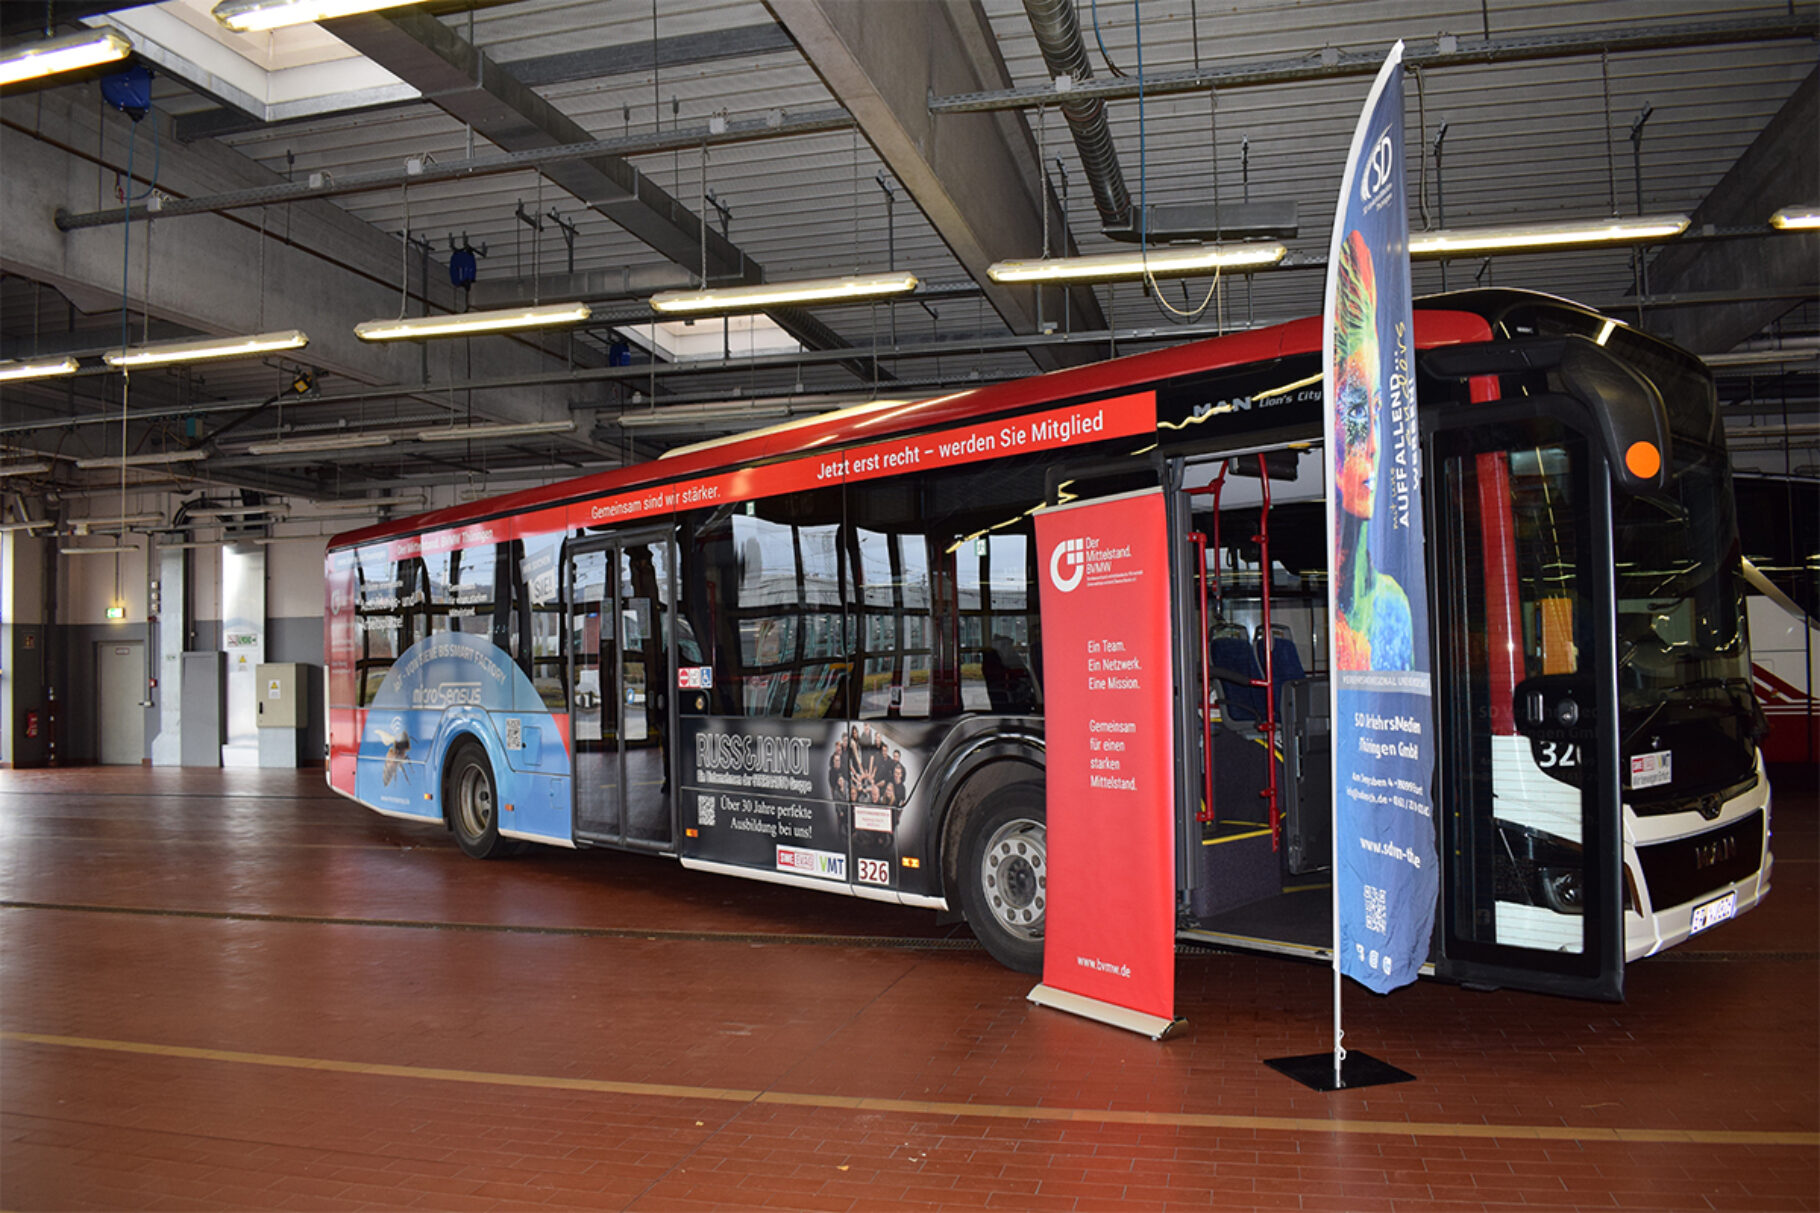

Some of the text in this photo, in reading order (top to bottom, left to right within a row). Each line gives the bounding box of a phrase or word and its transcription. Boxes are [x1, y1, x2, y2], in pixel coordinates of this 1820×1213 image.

[1193, 390, 1322, 418] MAN Lion's City
[817, 458, 850, 481] Jetzt
[853, 453, 880, 474] erst
[883, 446, 920, 469] recht
[938, 433, 996, 459] werden
[1000, 427, 1027, 449] Sie
[1031, 410, 1104, 443] Mitglied
[1390, 350, 1410, 528] AUFFALLEND...
[591, 499, 642, 520] Gemeinsam
[643, 494, 664, 511] sind
[682, 485, 721, 504] stärker.
[1085, 536, 1100, 549] Der
[1087, 640, 1126, 653] Ein Team.
[1088, 657, 1142, 672] Ein Netzwerk.
[1088, 676, 1141, 690] Eine Mission.
[1089, 719, 1136, 733] Gemeinsam
[1089, 738, 1125, 752] für einen
[1090, 757, 1120, 770] starken
[1090, 775, 1138, 791] Mittelstand.
[720, 794, 813, 820] Über 30 Jahre perfekte
[730, 817, 813, 839] Ausbildung bei uns!
[819, 856, 844, 875] VMT
[859, 860, 888, 883] 326
